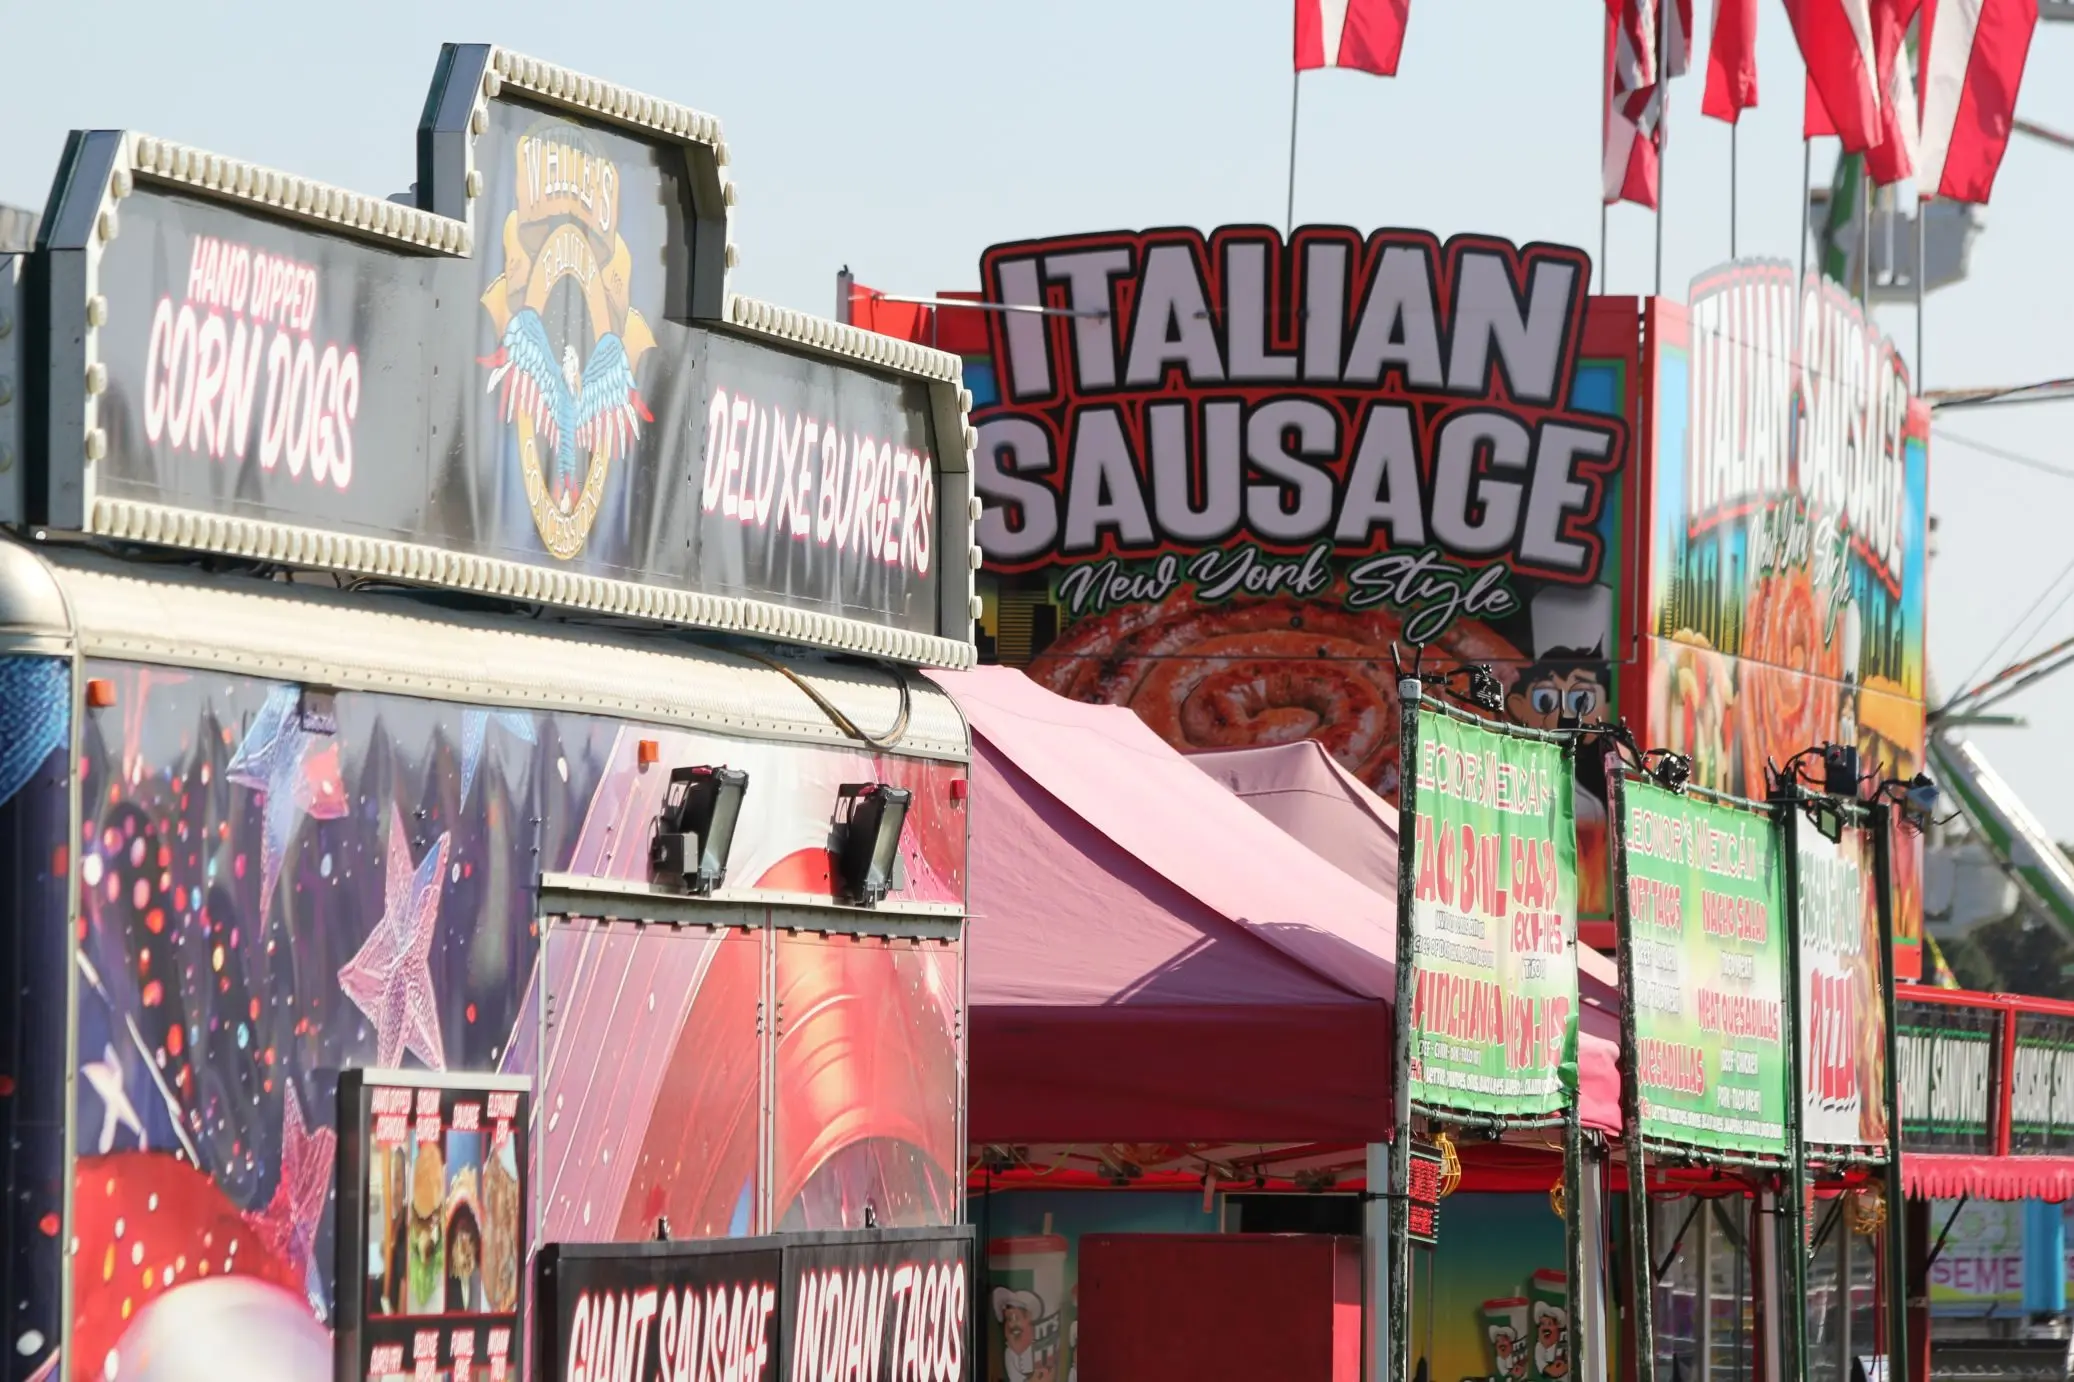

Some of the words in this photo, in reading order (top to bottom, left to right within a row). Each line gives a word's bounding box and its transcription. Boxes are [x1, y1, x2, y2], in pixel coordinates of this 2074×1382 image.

[188, 235, 248, 308] HAND
[251, 254, 318, 332] DIPPED
[998, 241, 1573, 401] ITALIAN
[144, 299, 261, 459] CORN
[258, 326, 360, 490] DOGS
[1689, 282, 1793, 520] ITALIAN
[1797, 287, 1909, 585] SAUSAGE
[702, 387, 819, 540] DELUXE
[816, 421, 936, 576] BURGERS
[975, 401, 1612, 569] SAUSAGE
[1060, 551, 1178, 612] New
[1188, 543, 1330, 599] York
[1349, 551, 1517, 642] Style
[1629, 874, 1650, 926] OFT
[1807, 966, 1857, 1101] PIZZA
[566, 1288, 659, 1382] GIANT
[656, 1283, 777, 1382] SAUSAGE
[793, 1265, 890, 1382] INDIAN
[890, 1261, 966, 1382] TACOS
